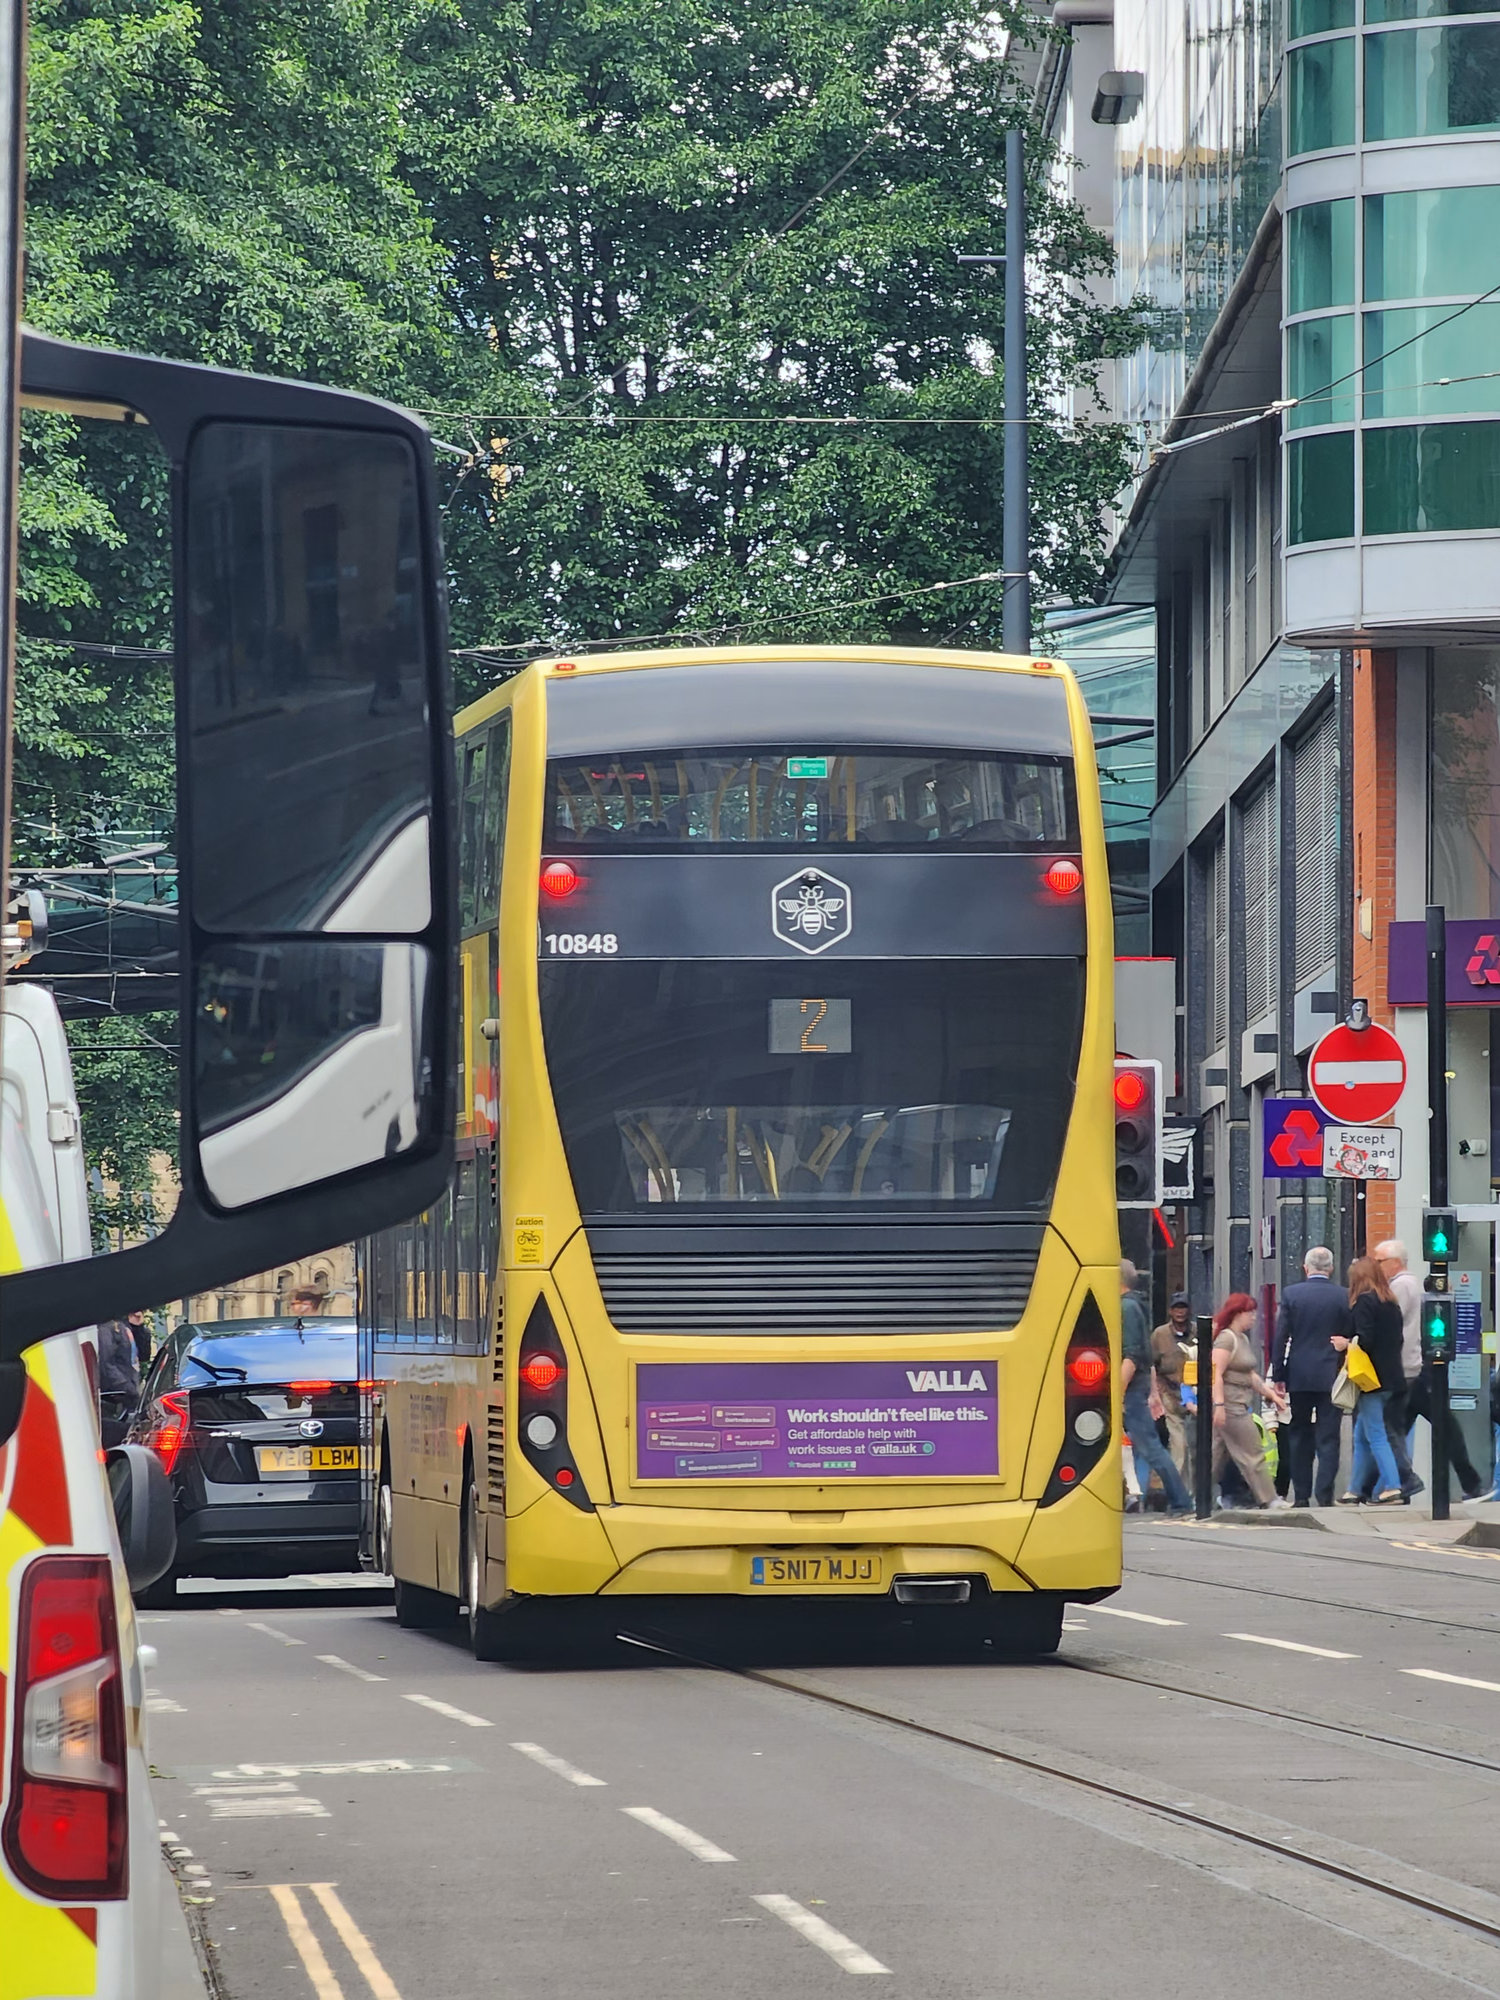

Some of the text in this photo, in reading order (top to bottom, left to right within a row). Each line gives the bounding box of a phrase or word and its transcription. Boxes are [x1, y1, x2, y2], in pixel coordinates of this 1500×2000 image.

[545, 933, 618, 954] 10848
[800, 998, 827, 1052] 2
[1340, 1132, 1386, 1145] Except
[1371, 1148, 1395, 1158] and
[515, 1217, 544, 1226] Caution
[906, 1370, 988, 1392] VALLA
[787, 1406, 989, 1423] Work shouldn't feel like this.
[788, 1427, 917, 1441] Get affordable help with
[319, 1449, 354, 1466] LBM
[788, 1443, 917, 1455] work issues at valla.uk
[771, 1559, 872, 1580] SN17 MJJ
